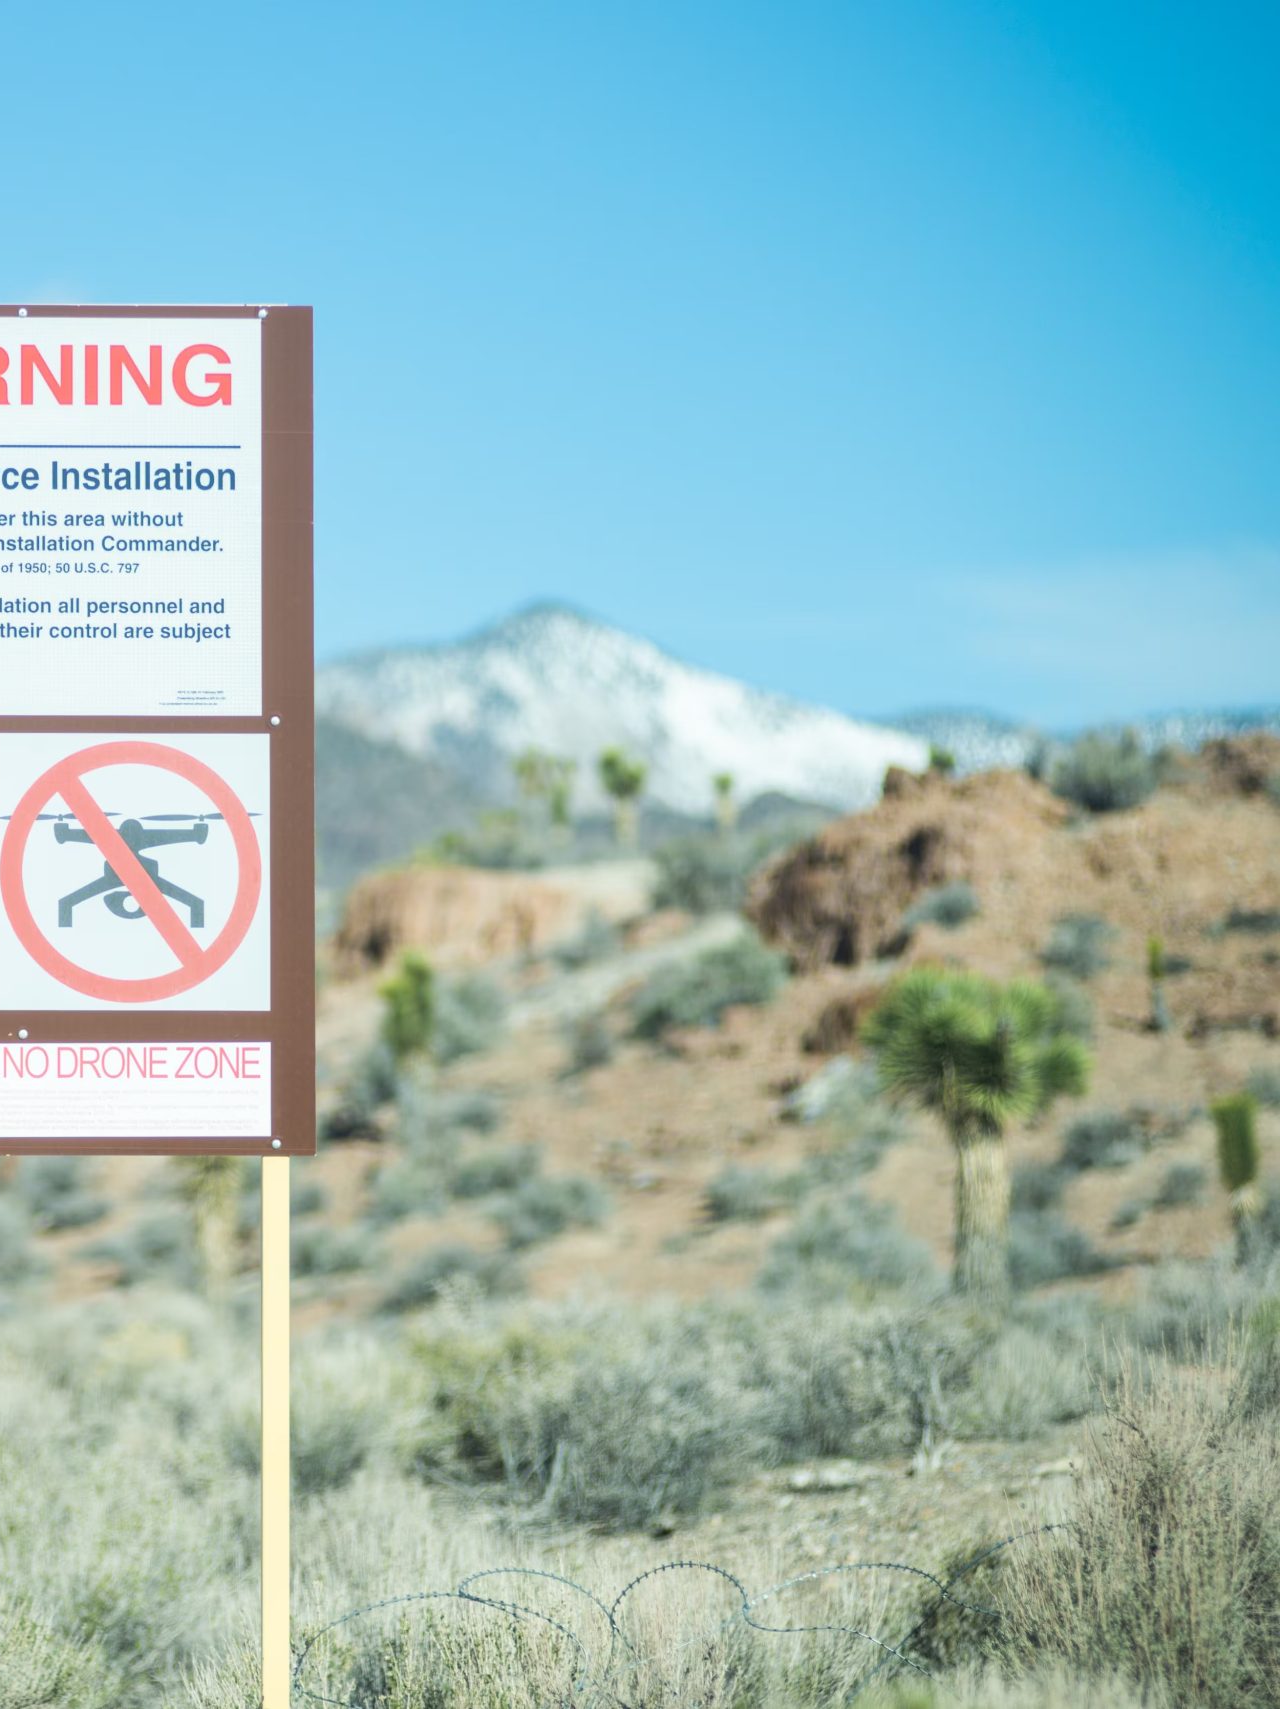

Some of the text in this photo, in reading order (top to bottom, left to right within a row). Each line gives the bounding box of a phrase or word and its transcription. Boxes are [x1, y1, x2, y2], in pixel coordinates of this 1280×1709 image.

[52, 461, 235, 490] Installation
[22, 511, 57, 526] this
[64, 515, 104, 526] area
[112, 511, 183, 526] without
[102, 536, 223, 551] Commander.
[1, 563, 13, 573] of
[19, 562, 52, 575] 1950;
[56, 563, 70, 573] 50
[74, 562, 113, 573] U.S.C.
[118, 563, 139, 573] 797
[59, 598, 79, 613] all
[87, 598, 182, 617] personnel
[190, 599, 224, 613] and
[0, 623, 42, 638] their
[50, 623, 116, 638] control
[124, 627, 153, 638] are
[161, 623, 230, 642] subject
[3, 1046, 260, 1079] NO DRONE ZONE
